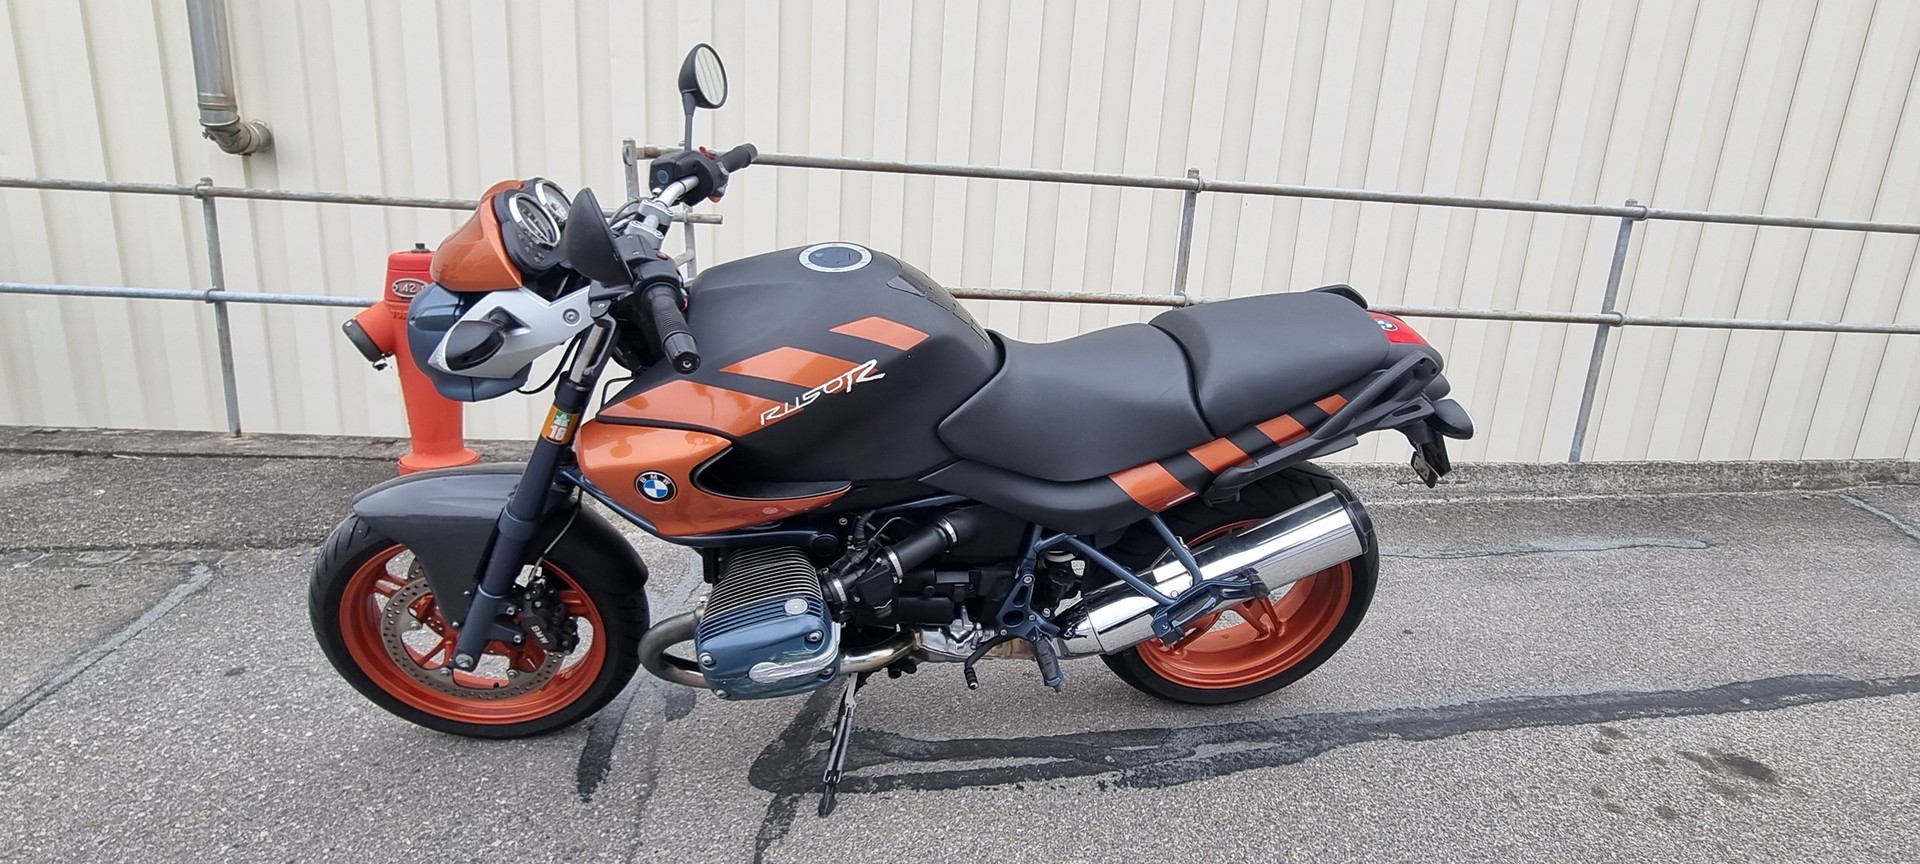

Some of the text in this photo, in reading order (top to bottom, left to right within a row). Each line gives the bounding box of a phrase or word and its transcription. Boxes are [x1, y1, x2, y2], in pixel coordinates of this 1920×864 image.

[401, 283, 416, 293] 42
[550, 424, 567, 441] 18
[639, 474, 671, 485] BMW
[530, 625, 550, 644] BMW
